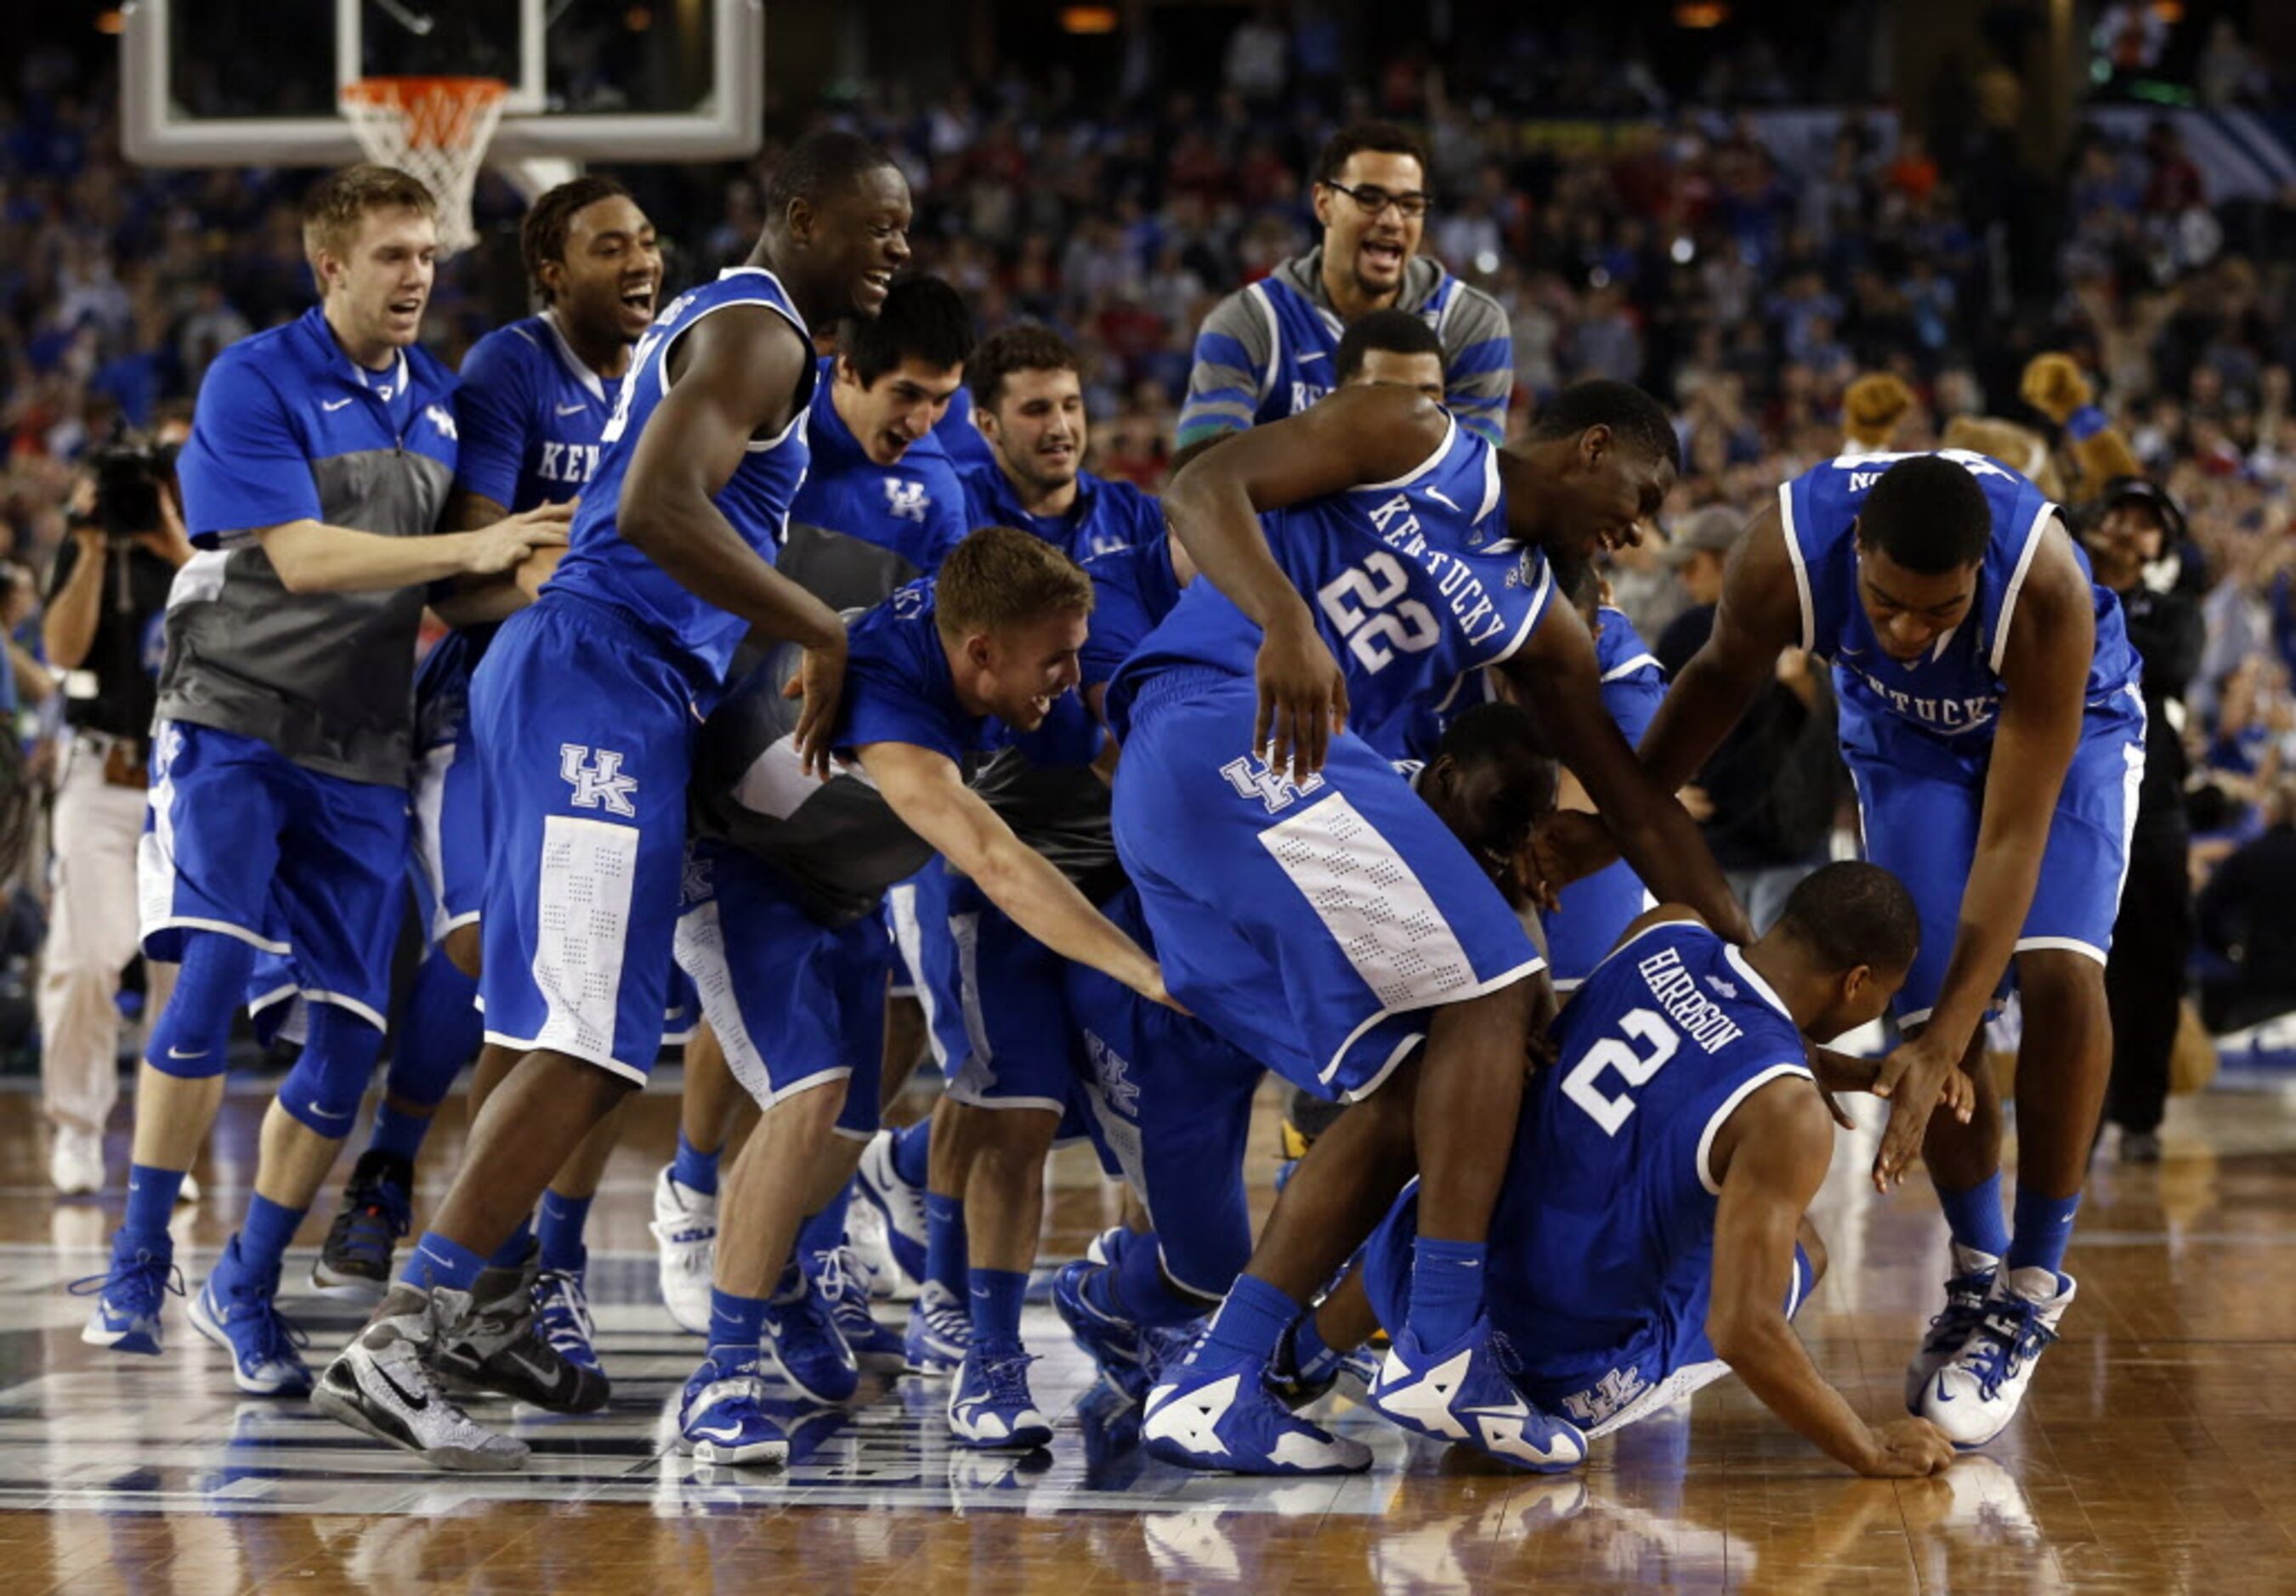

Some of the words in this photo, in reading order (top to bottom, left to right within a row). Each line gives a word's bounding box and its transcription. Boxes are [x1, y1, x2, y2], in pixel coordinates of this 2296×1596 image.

[882, 477, 932, 523] UK
[1368, 492, 1505, 646] KENTUCKY
[1318, 551, 1440, 676] 22
[560, 743, 638, 818] UK
[1219, 739, 1326, 814] UK
[1560, 1007, 1681, 1137] 2
[1562, 1365, 1646, 1427] UK
